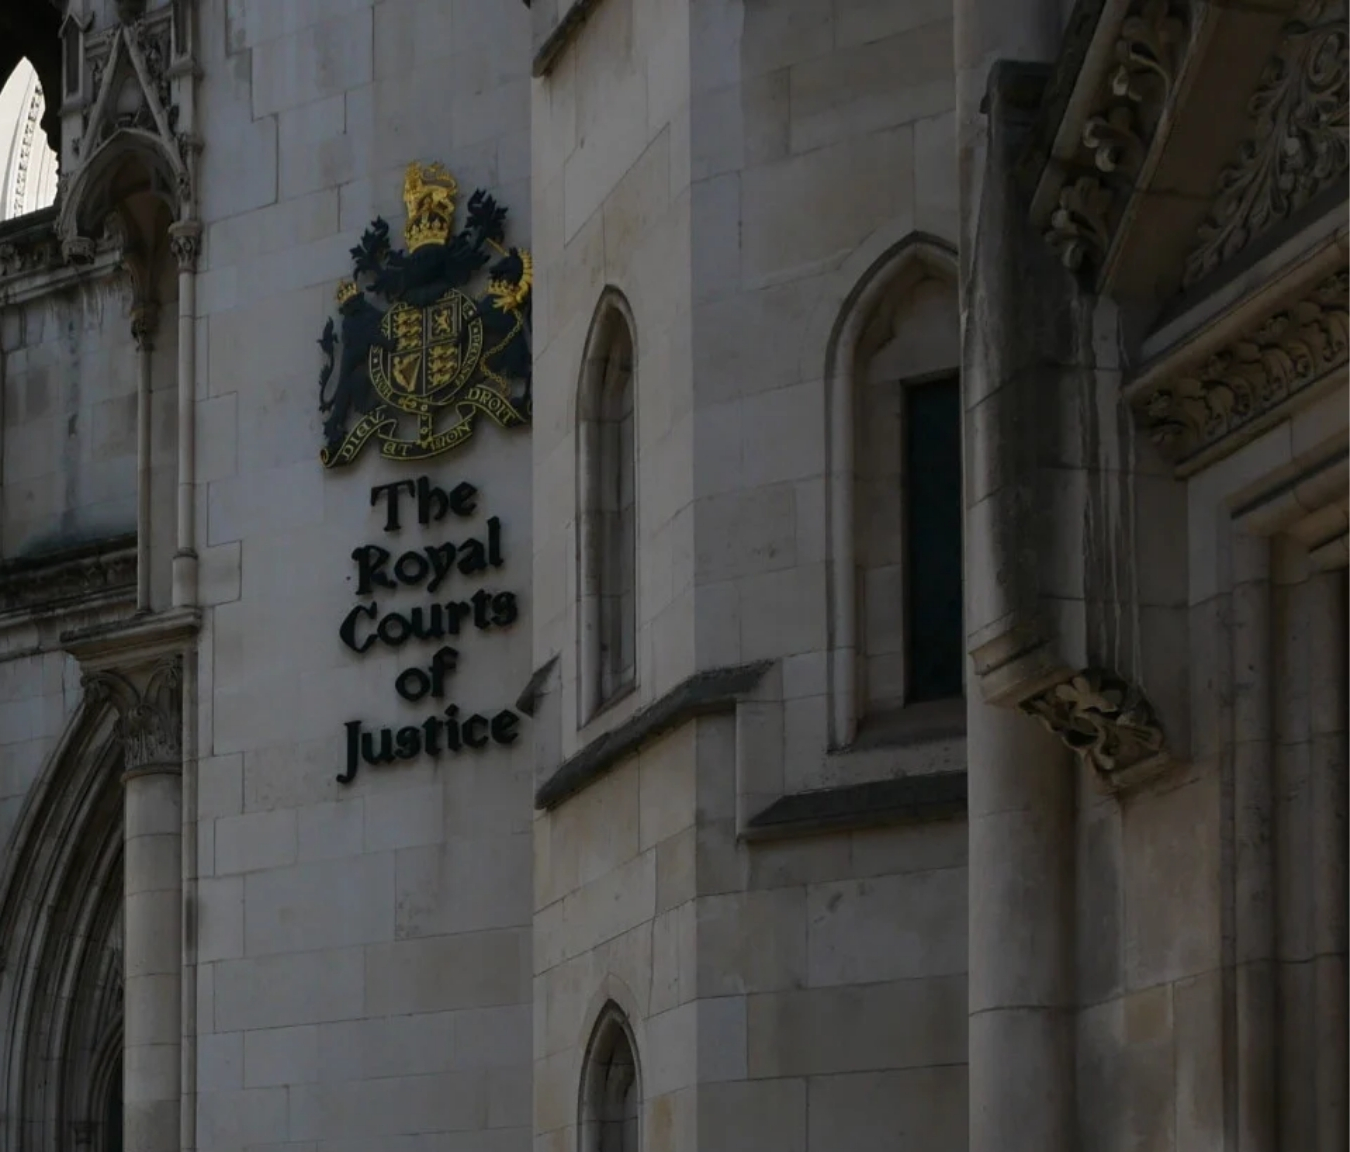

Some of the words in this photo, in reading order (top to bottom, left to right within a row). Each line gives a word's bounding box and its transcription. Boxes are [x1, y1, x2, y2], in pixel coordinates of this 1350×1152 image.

[466, 387, 517, 424] DROIT
[370, 475, 478, 532] The
[351, 515, 504, 595] Royal
[339, 589, 519, 653] Courts
[395, 645, 459, 700] of
[336, 703, 520, 784] Justice
